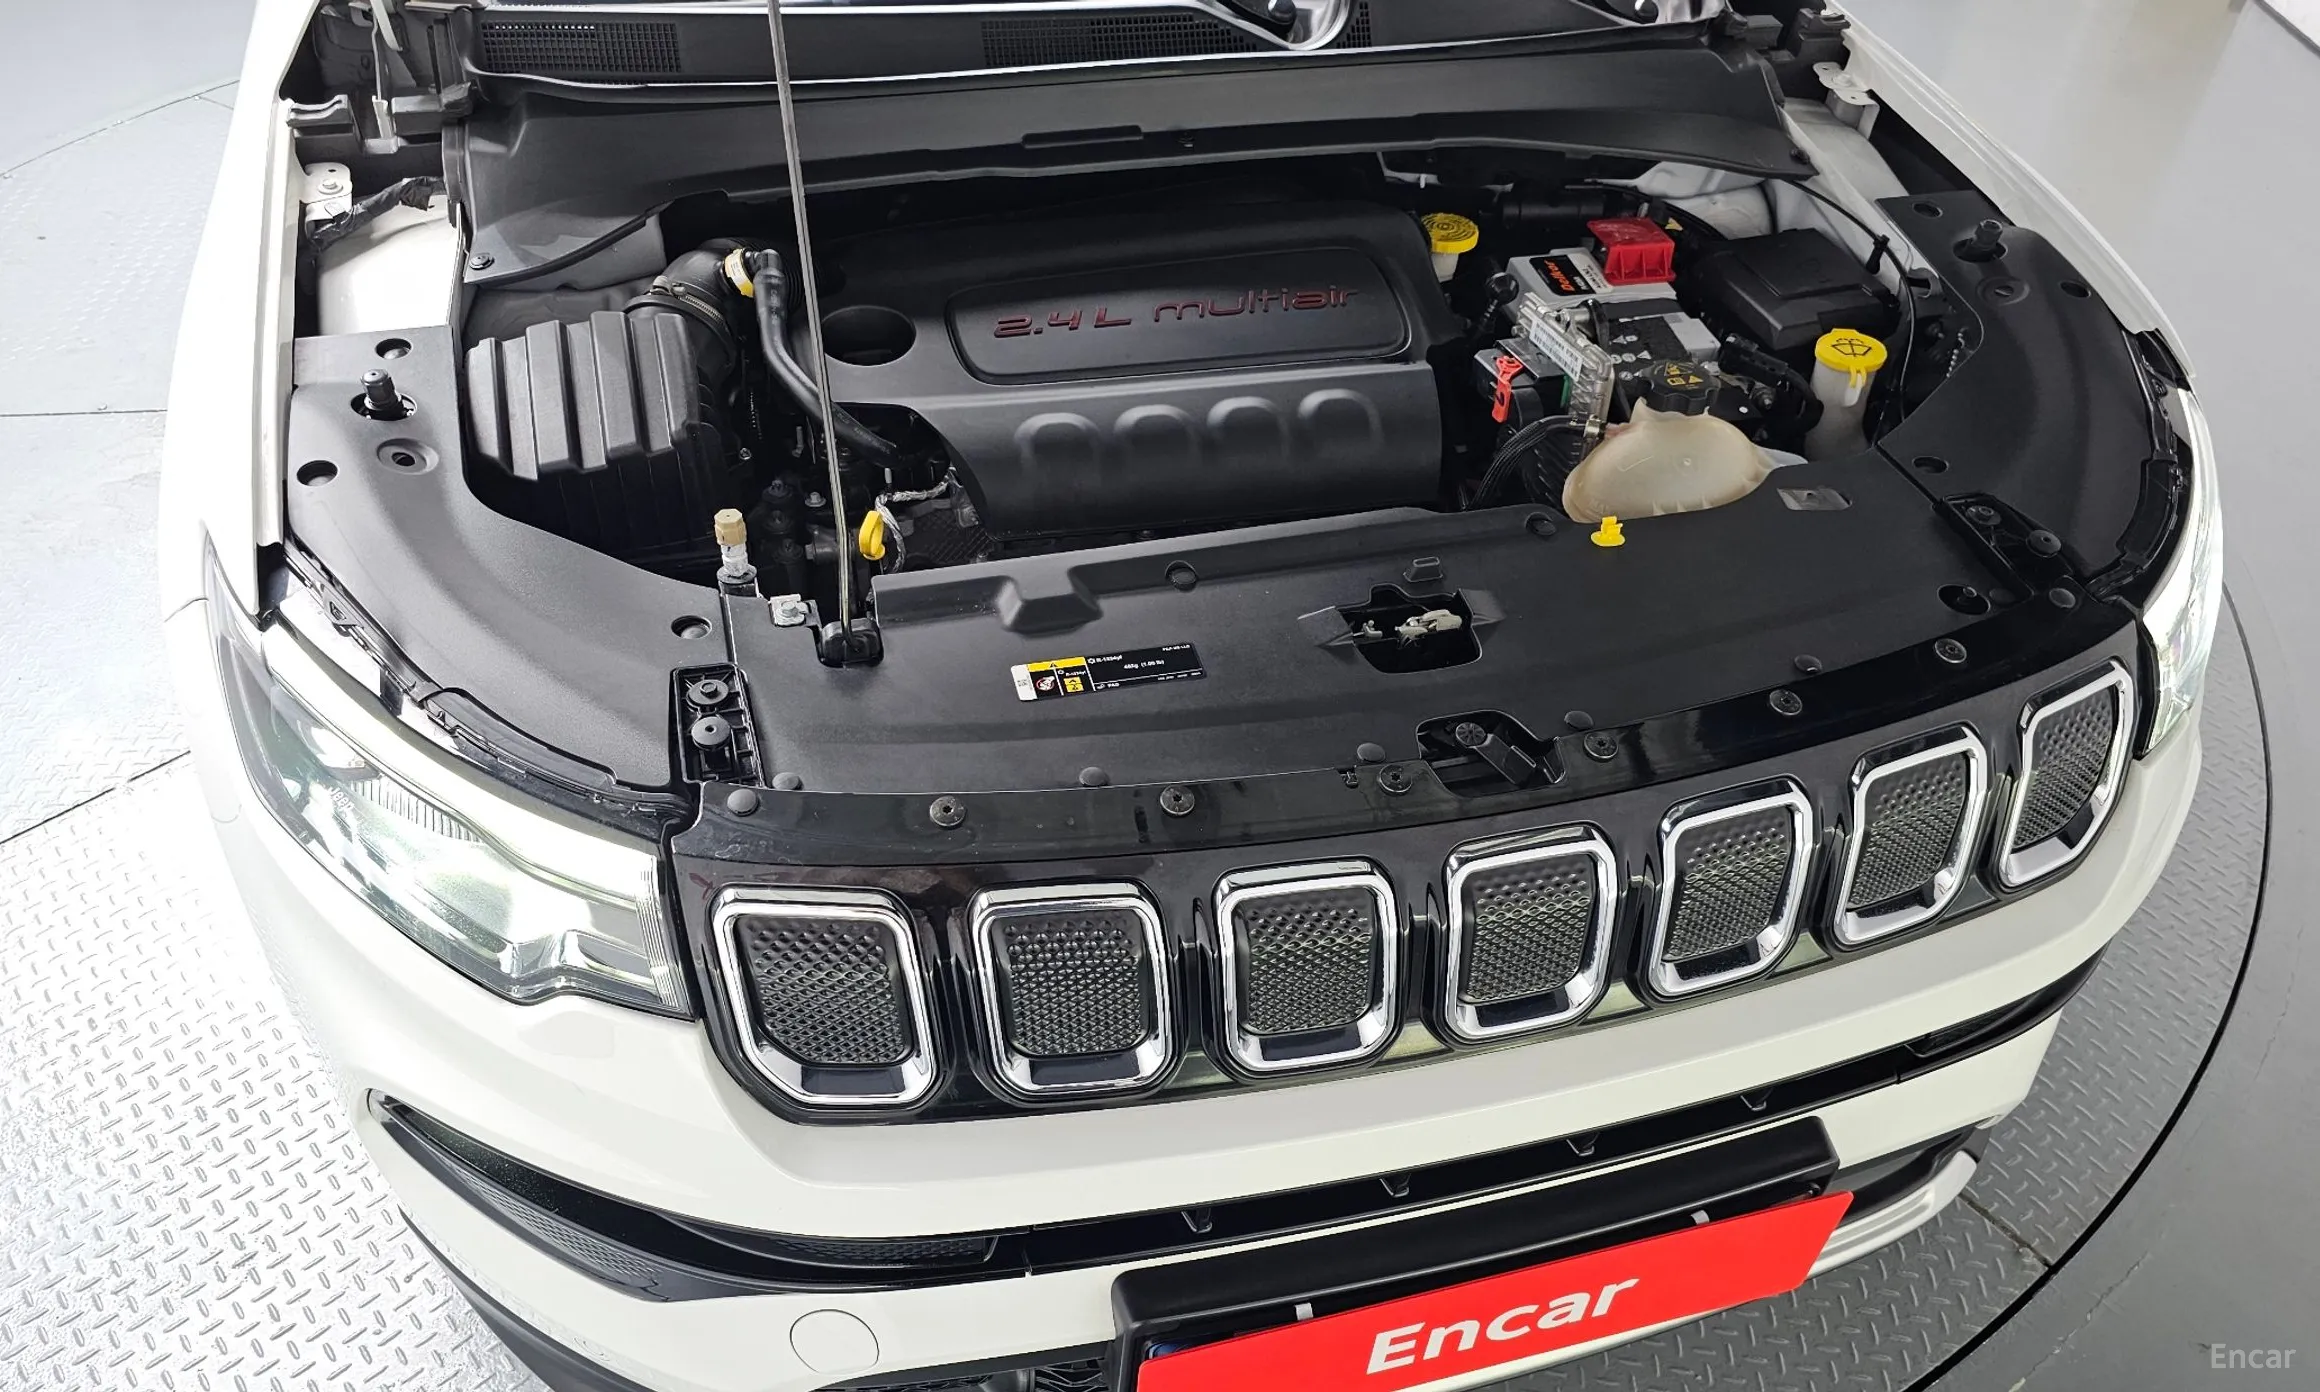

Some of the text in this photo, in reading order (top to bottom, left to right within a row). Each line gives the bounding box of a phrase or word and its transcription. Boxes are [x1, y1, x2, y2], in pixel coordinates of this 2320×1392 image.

[1543, 259, 1576, 292] Delkor
[1154, 285, 1359, 322] multiair
[329, 786, 355, 812] Jeep
[1366, 1278, 1640, 1375] Encar
